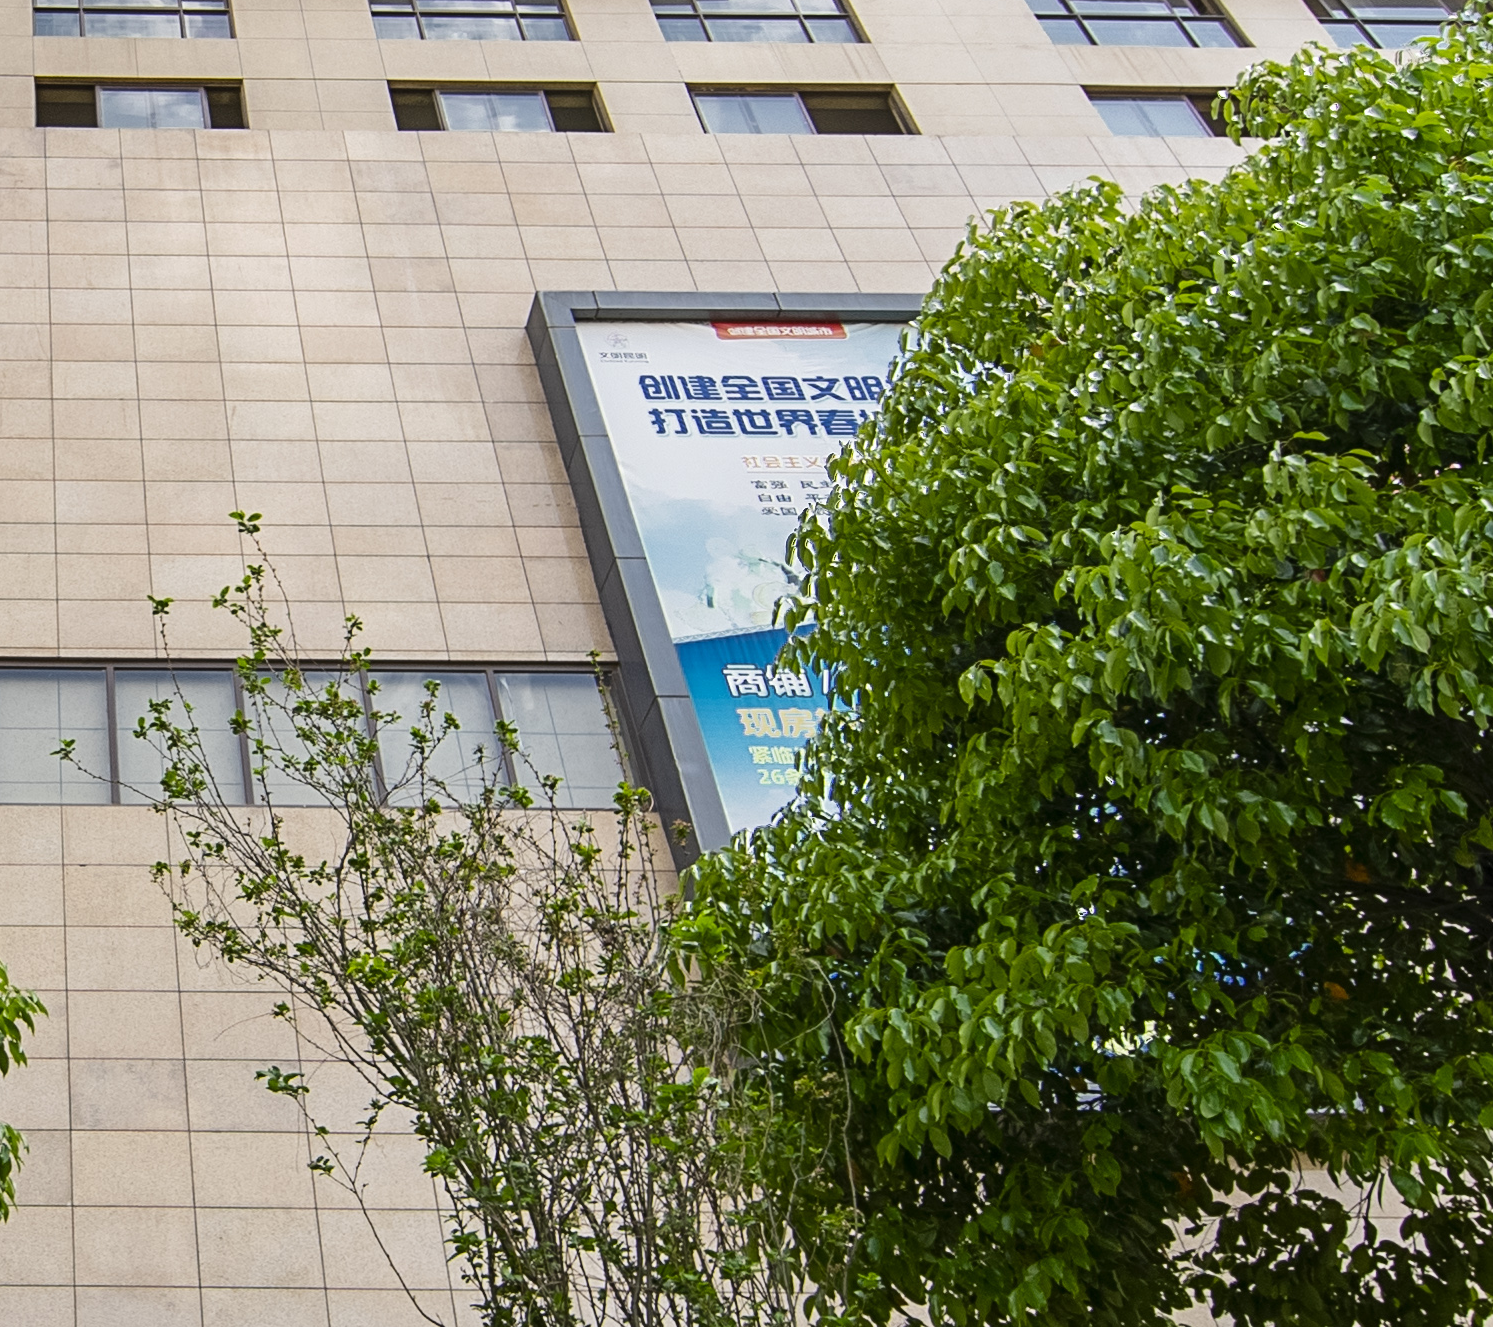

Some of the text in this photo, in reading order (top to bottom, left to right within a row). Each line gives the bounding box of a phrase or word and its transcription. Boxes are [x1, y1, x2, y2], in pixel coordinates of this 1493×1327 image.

[639, 374, 886, 401] 创建全国文明
[750, 480, 788, 489] 富强
[757, 493, 792, 503] 自由
[736, 708, 826, 737] 现房
